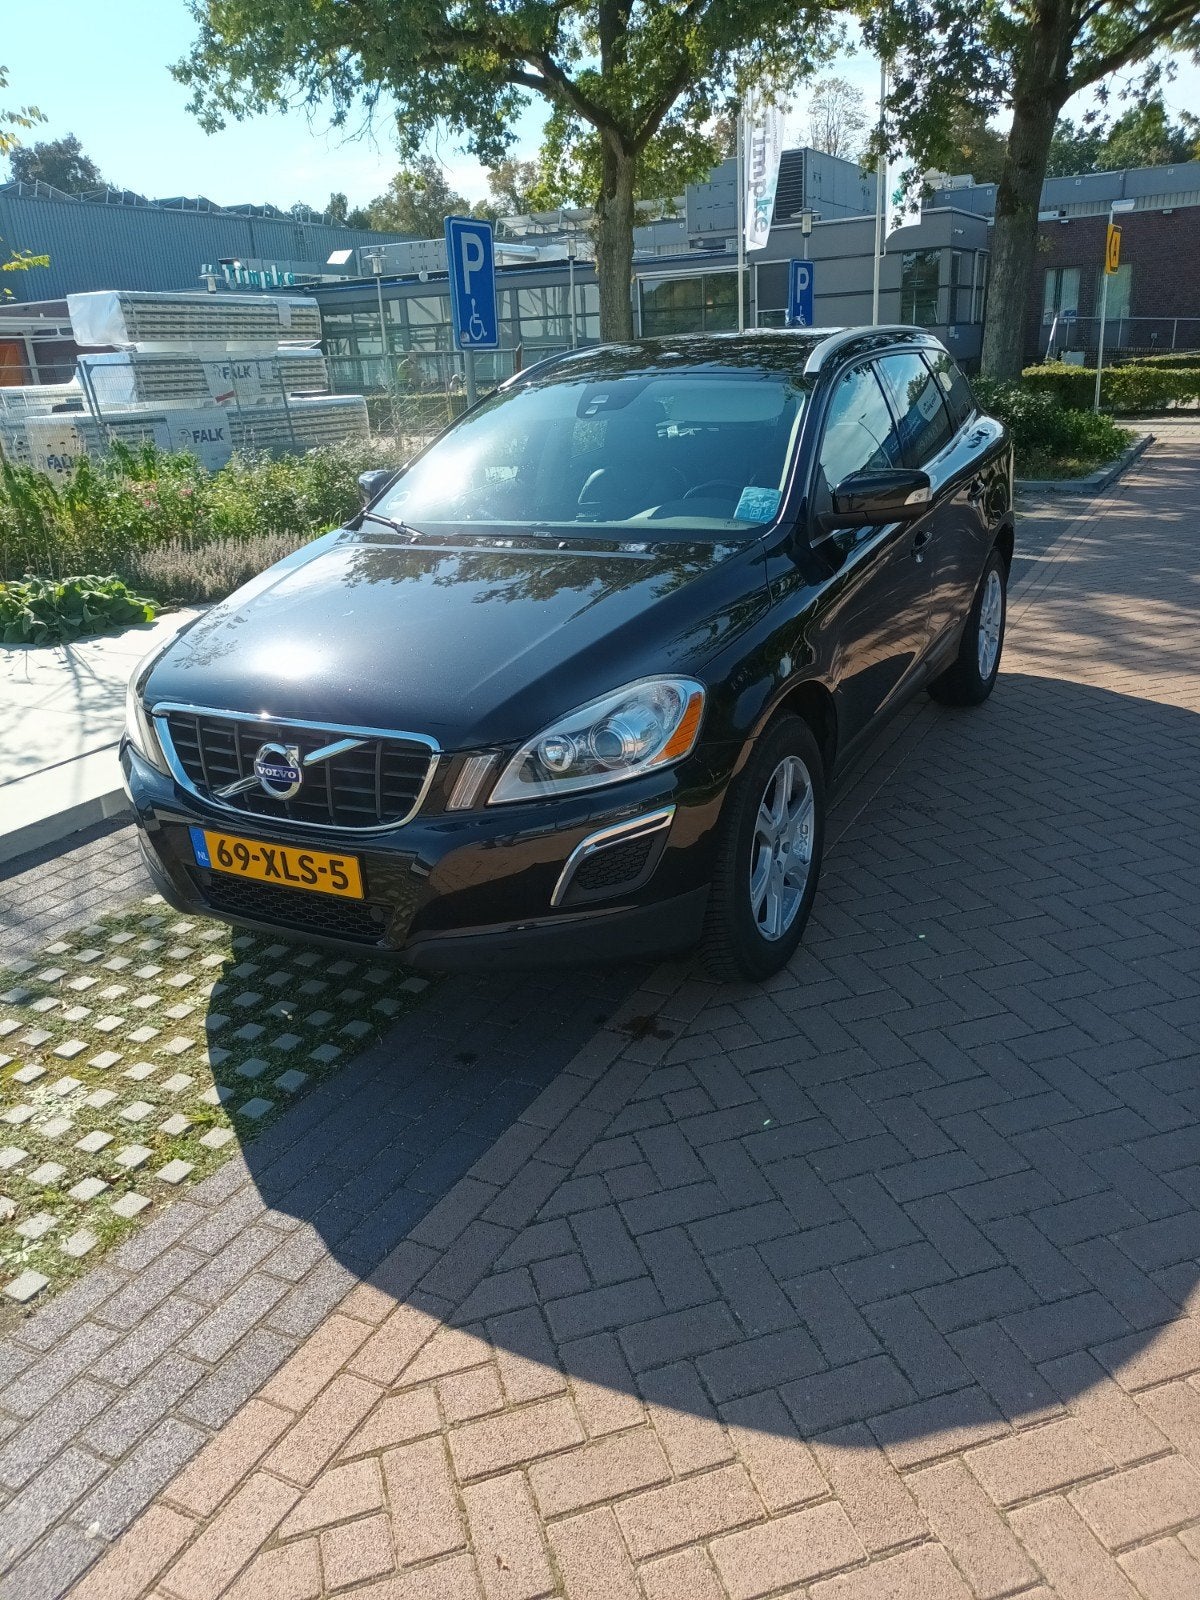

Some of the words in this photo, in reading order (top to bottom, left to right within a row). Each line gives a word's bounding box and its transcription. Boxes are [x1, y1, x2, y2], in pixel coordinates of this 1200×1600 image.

[460, 231, 485, 295] P
[796, 266, 810, 304] P
[222, 365, 252, 379] FALK
[192, 427, 224, 444] FALK
[256, 765, 297, 779] VOLVO
[197, 850, 209, 861] NL
[216, 838, 349, 890] 69-XLS-5
